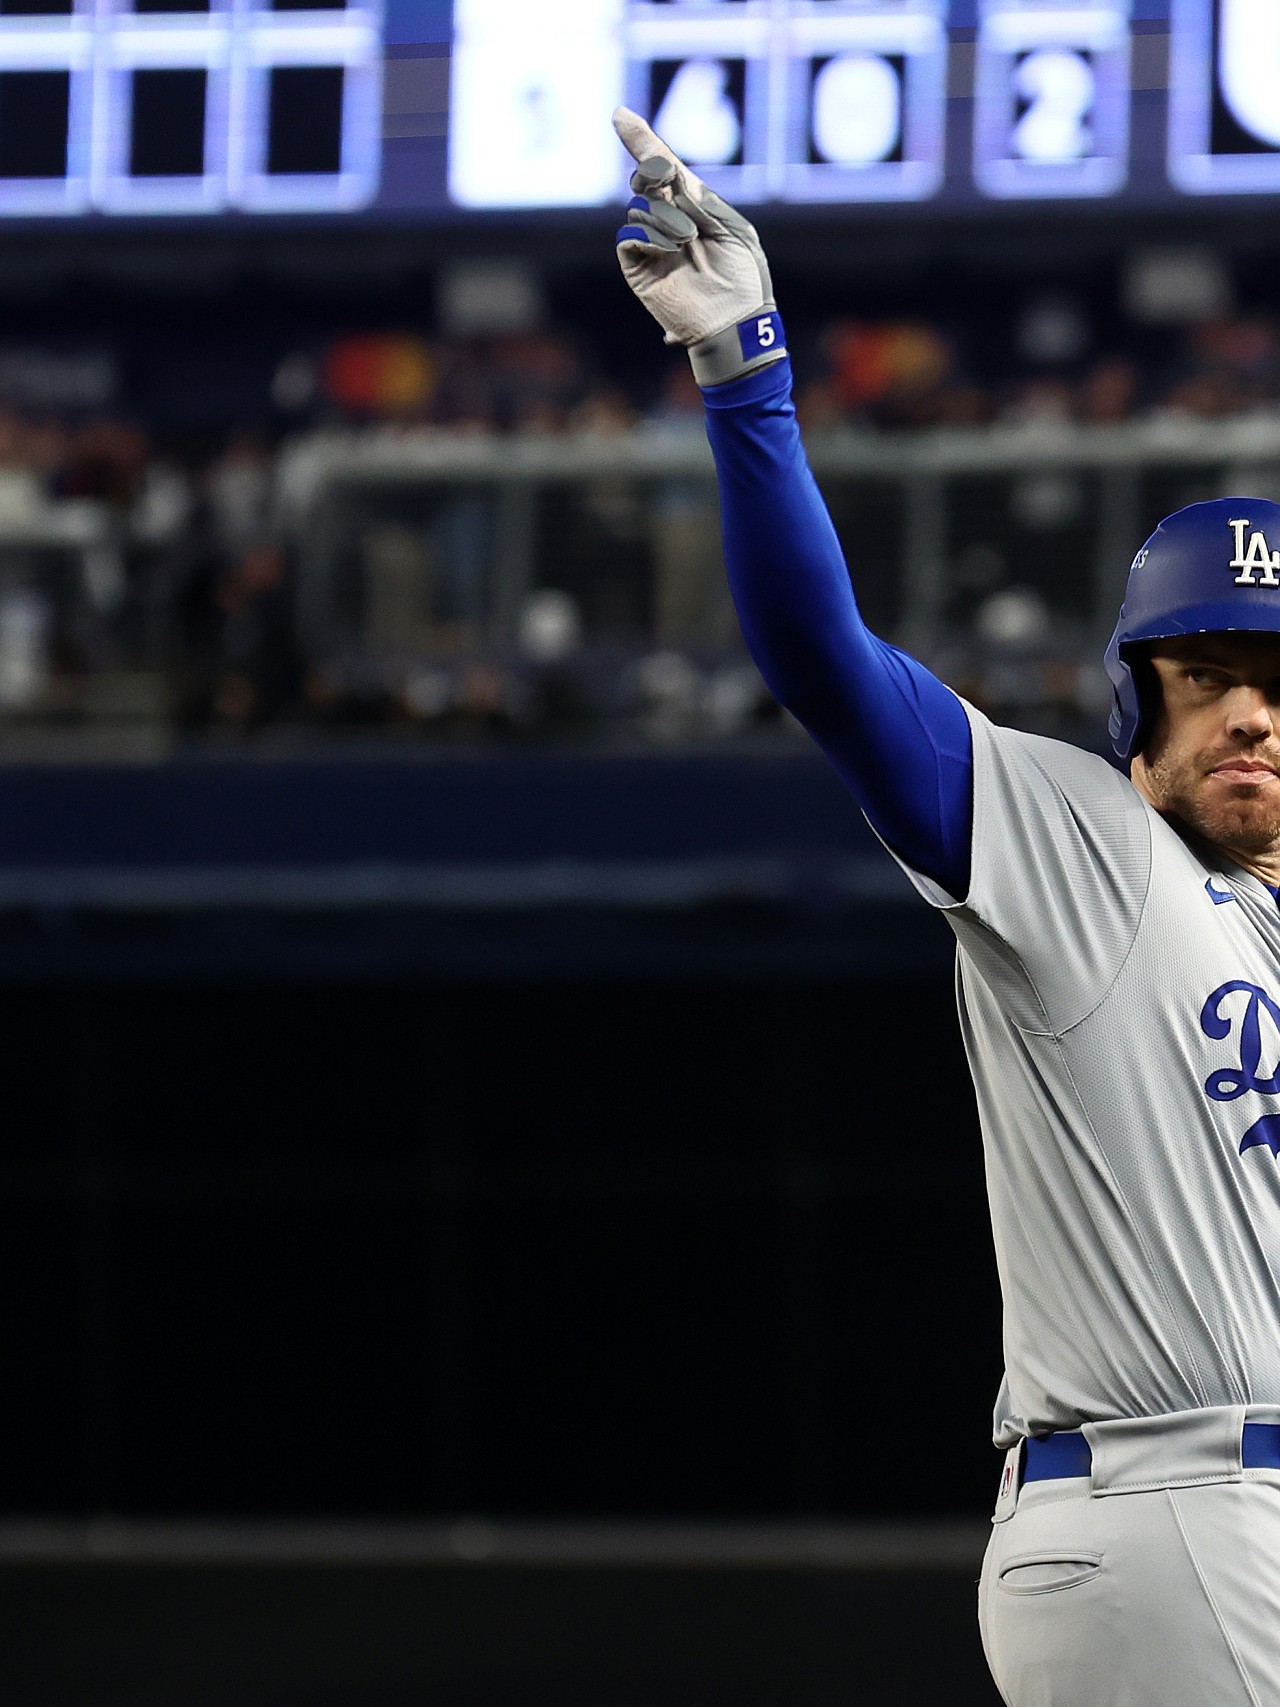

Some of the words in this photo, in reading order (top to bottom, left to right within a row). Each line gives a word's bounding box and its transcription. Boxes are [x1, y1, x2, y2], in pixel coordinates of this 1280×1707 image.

[1013, 52, 1093, 164] 2
[757, 317, 775, 346] 5
[1229, 519, 1280, 586] LA
